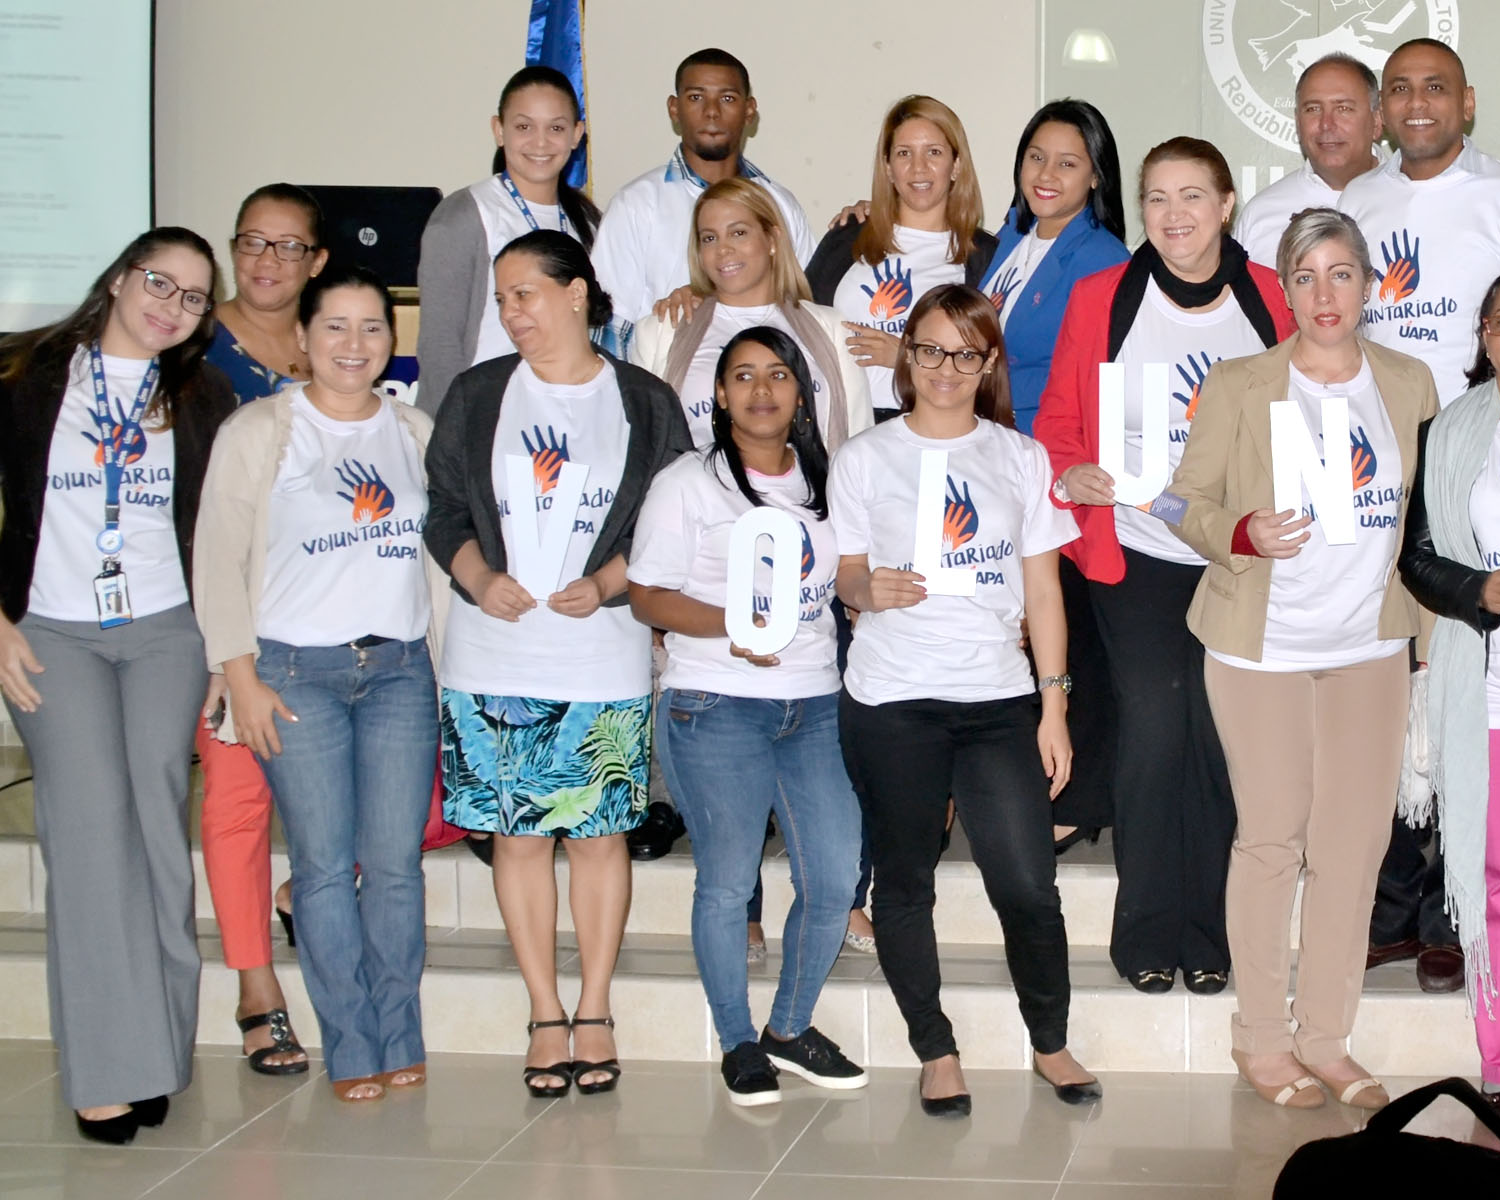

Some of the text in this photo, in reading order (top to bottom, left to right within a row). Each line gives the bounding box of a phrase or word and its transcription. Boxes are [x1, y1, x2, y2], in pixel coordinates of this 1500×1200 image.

[1221, 75, 1300, 145] Repúblic
[362, 227, 375, 246] hp
[1399, 325, 1438, 342] UAPA
[913, 450, 976, 597] L
[1098, 362, 1169, 507] U
[1270, 397, 1357, 546] N
[377, 544, 417, 560] UAPA
[976, 571, 1004, 585] APA
